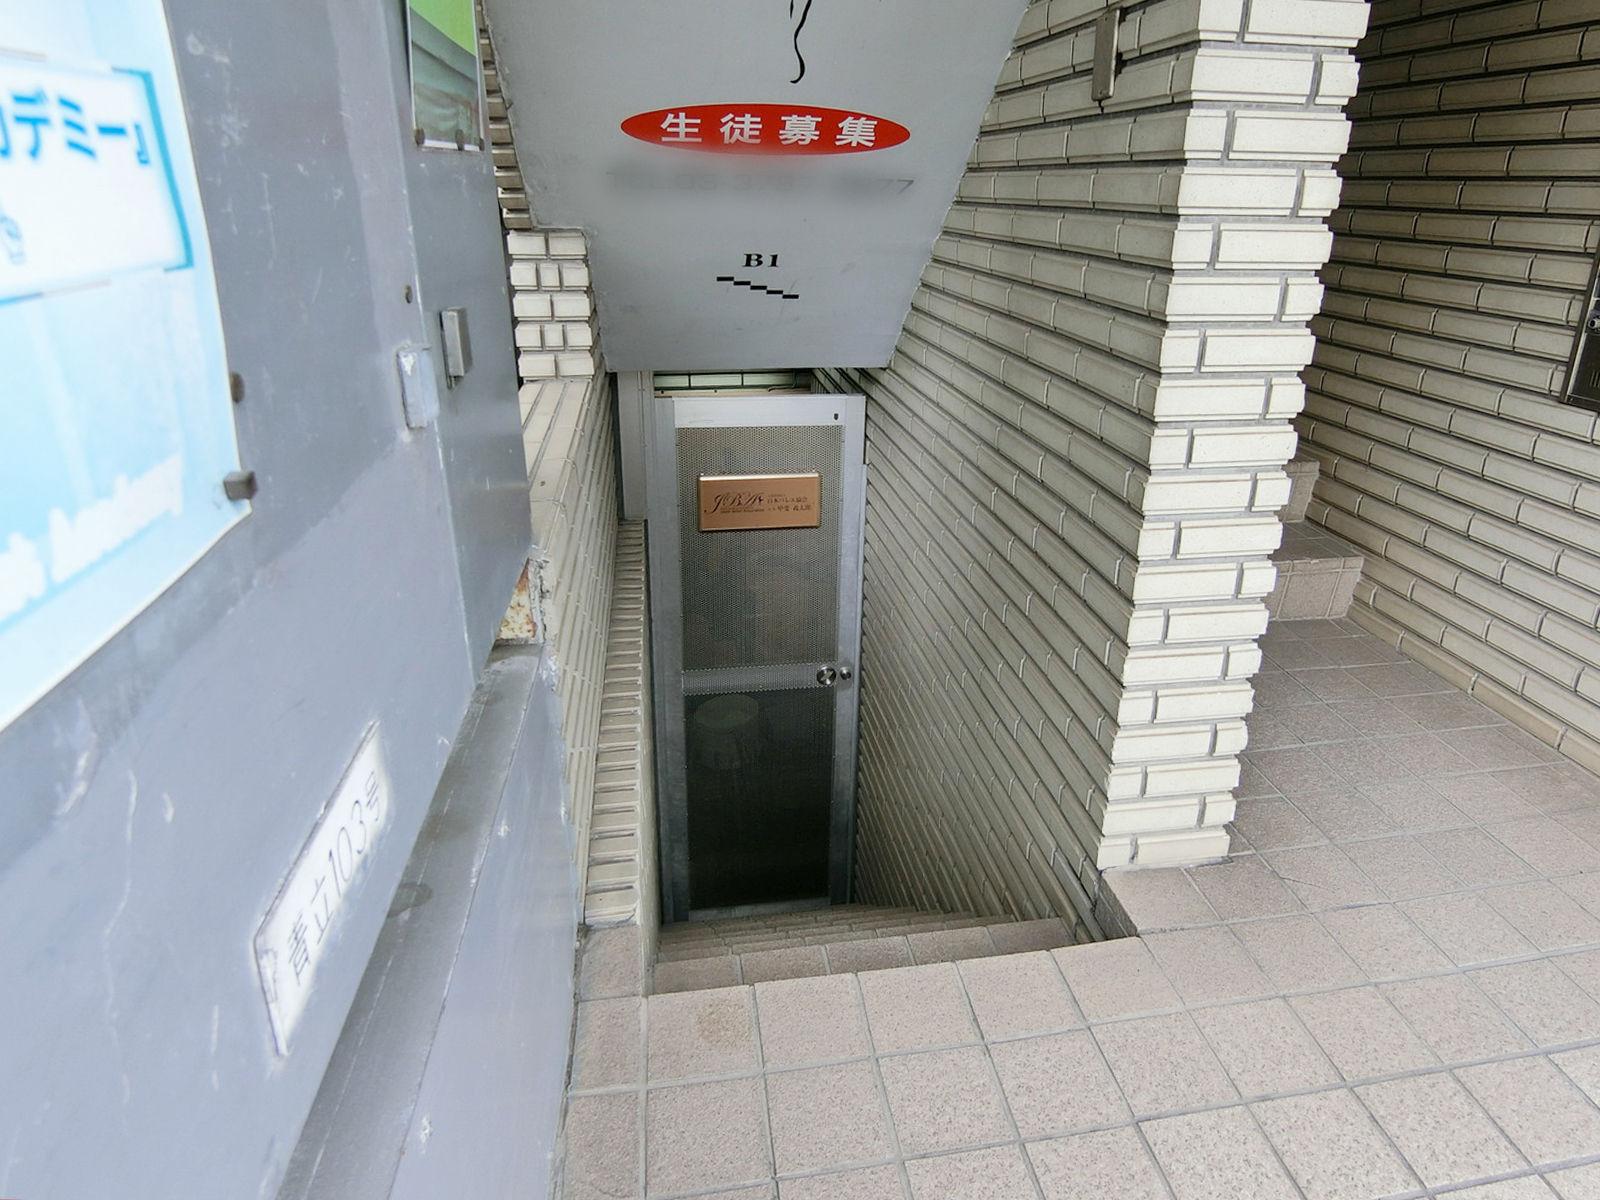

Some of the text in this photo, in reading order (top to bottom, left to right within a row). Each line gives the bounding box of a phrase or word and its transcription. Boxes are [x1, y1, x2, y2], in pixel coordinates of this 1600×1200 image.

[660, 112, 878, 147] 生徒募集
[742, 253, 780, 268] B1
